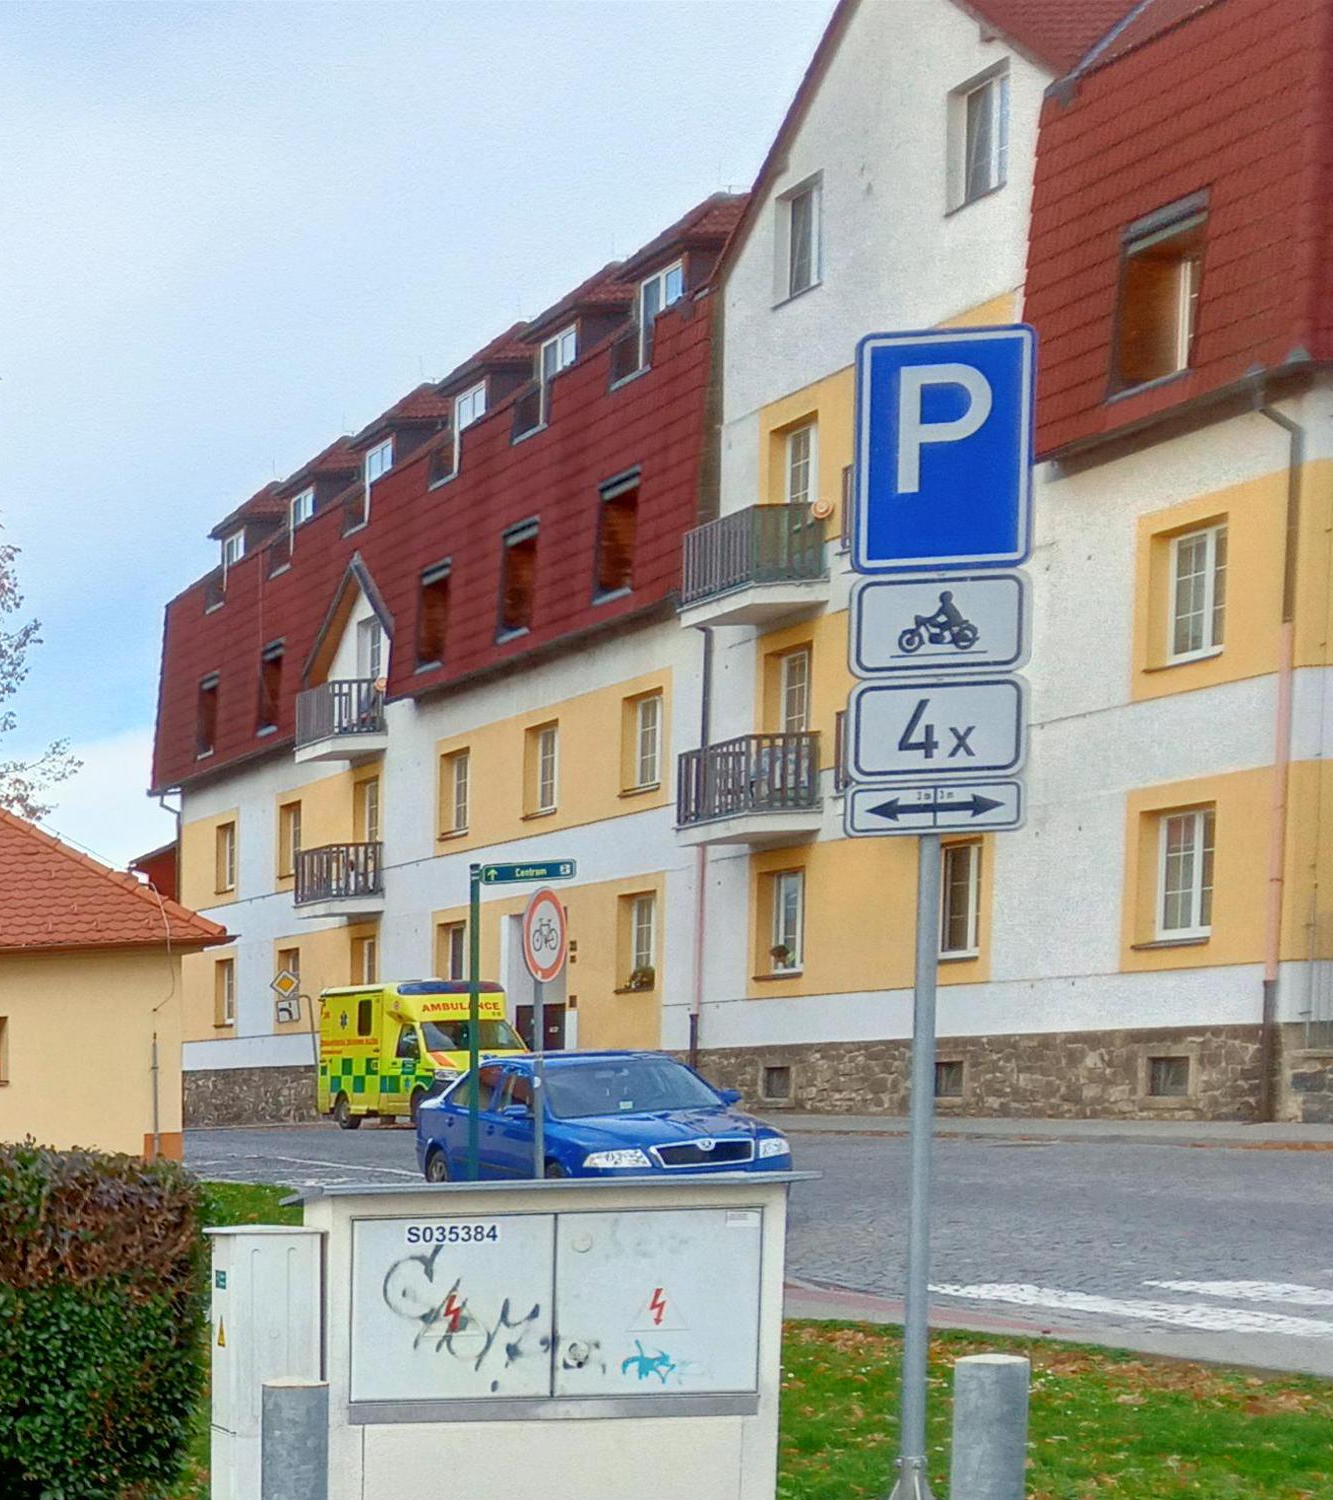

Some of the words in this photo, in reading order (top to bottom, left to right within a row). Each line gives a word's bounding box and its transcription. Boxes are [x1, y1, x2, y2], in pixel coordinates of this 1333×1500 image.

[897, 363, 993, 494] P
[422, 1001, 501, 1012] AMBULNCE
[407, 1225, 498, 1243] S035384
